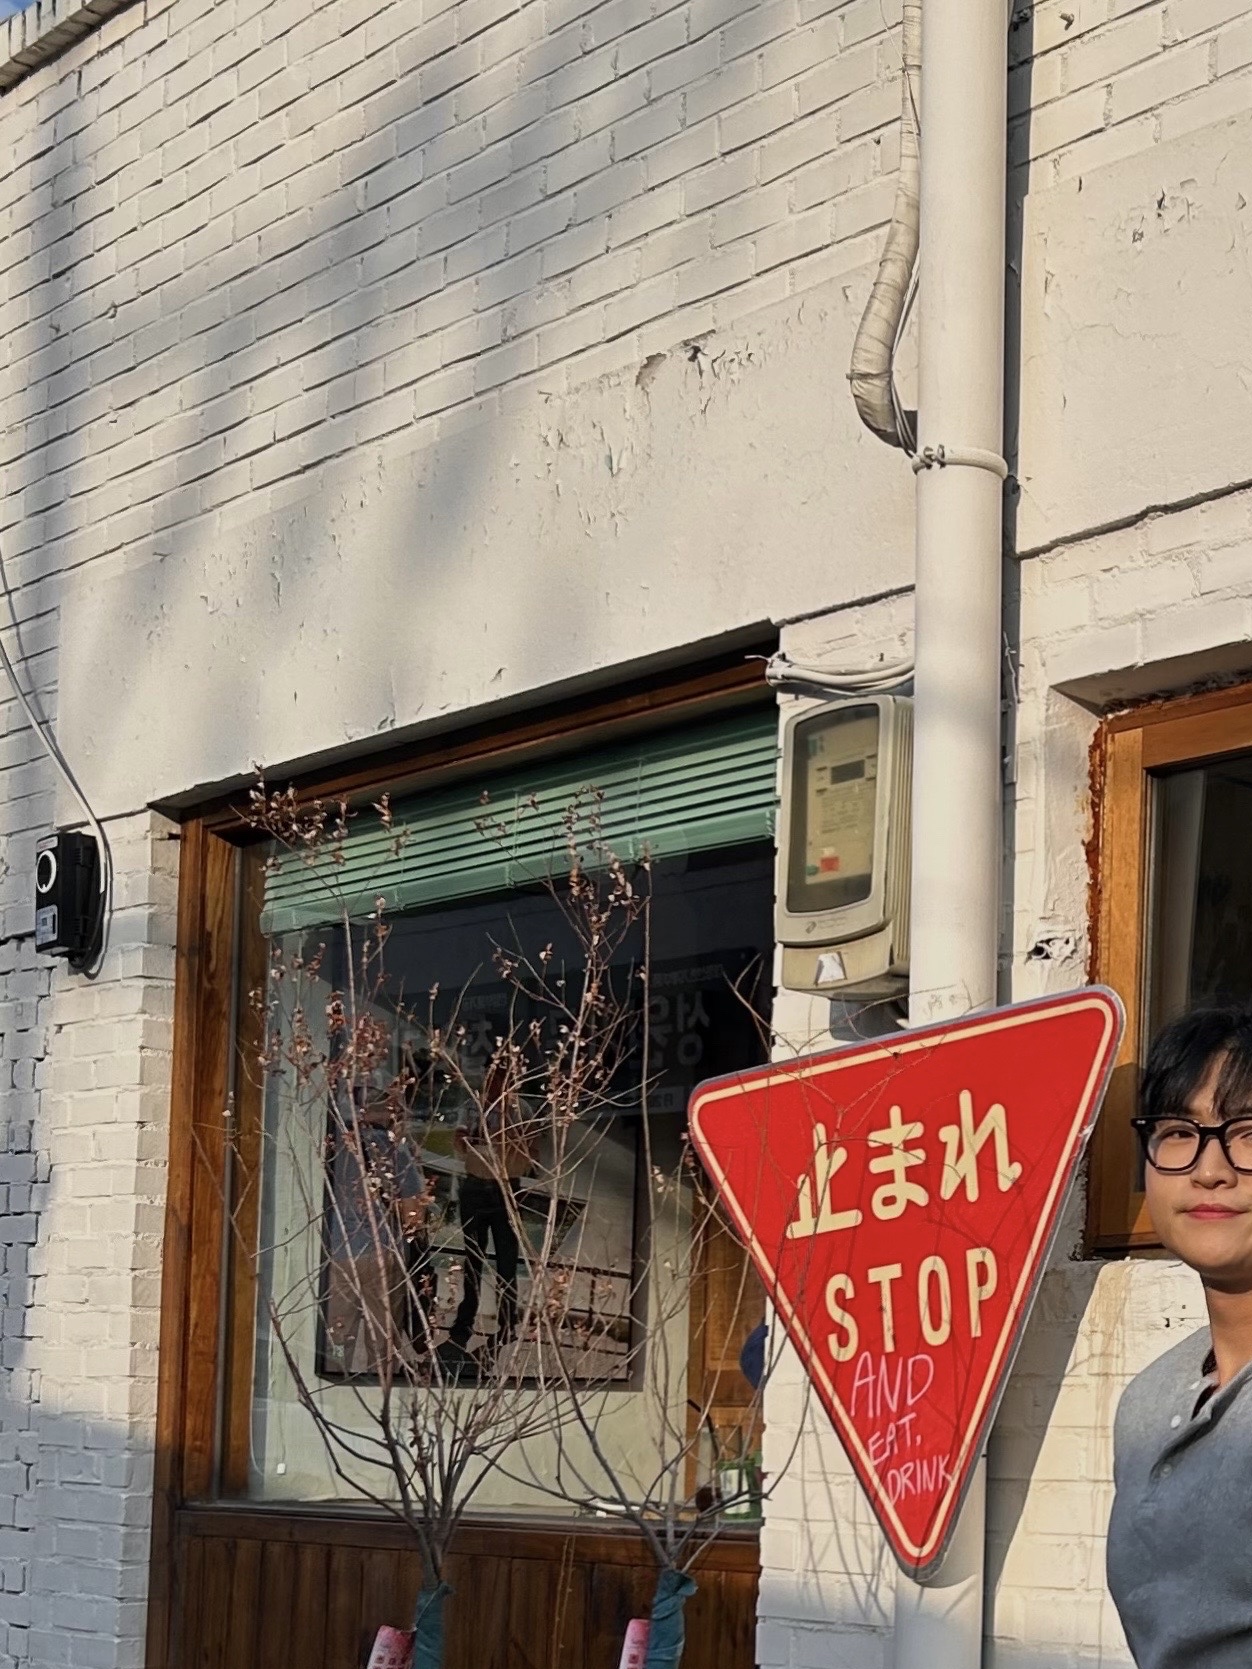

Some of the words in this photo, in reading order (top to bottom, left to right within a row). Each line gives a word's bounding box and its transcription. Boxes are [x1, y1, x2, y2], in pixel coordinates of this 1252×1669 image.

[785, 1089, 1022, 1240] 止まれ
[825, 1247, 999, 1362] STOP
[851, 1350, 935, 1419] AND
[868, 1412, 922, 1467] EAT,
[887, 1453, 953, 1506] DRINK
